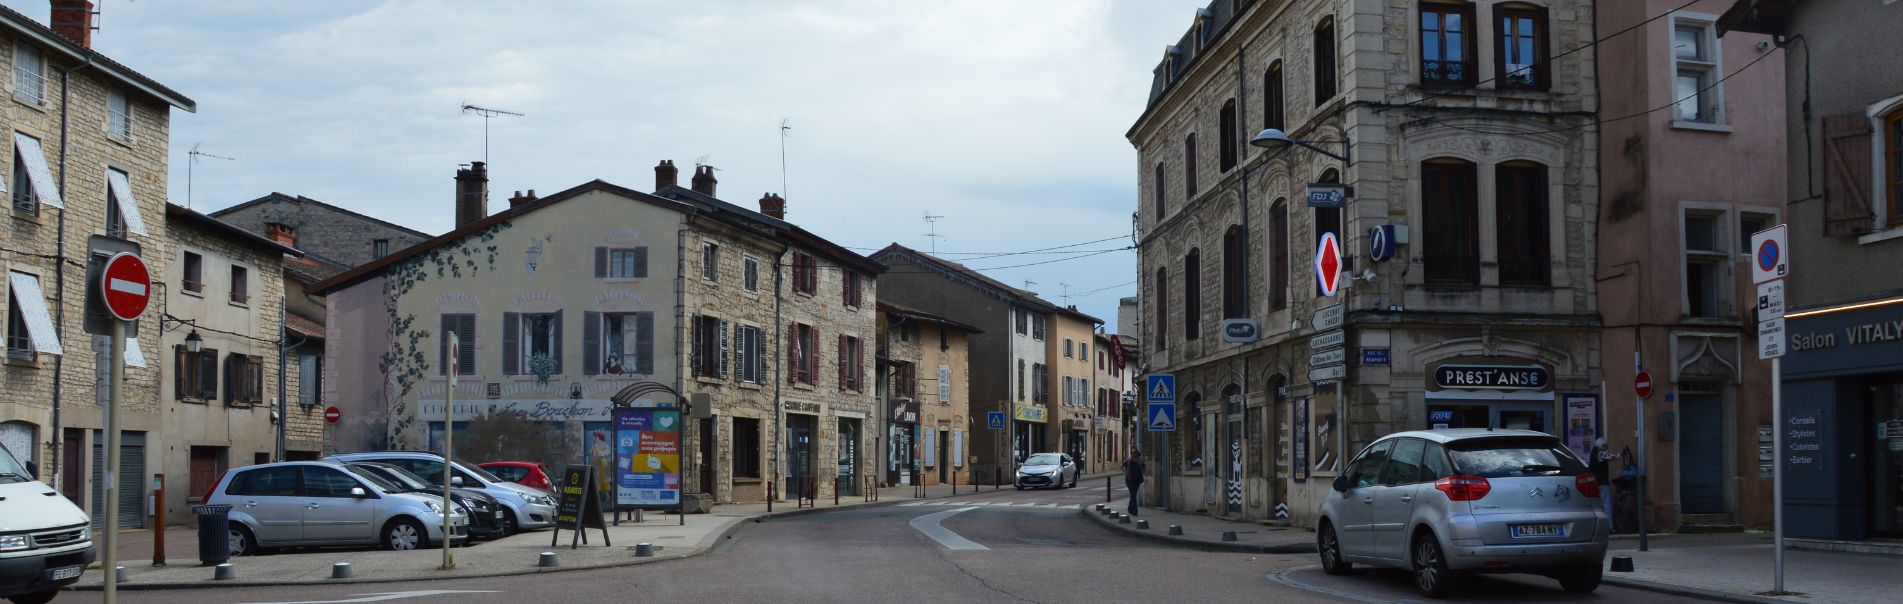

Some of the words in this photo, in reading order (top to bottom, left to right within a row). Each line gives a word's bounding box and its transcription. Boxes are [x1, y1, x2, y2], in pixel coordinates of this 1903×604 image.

[1322, 308, 1340, 318] LUCENAY
[1791, 332, 1836, 351] Salon
[1446, 369, 1538, 385] PREST'ANSE
[530, 402, 593, 417] Bouchon
